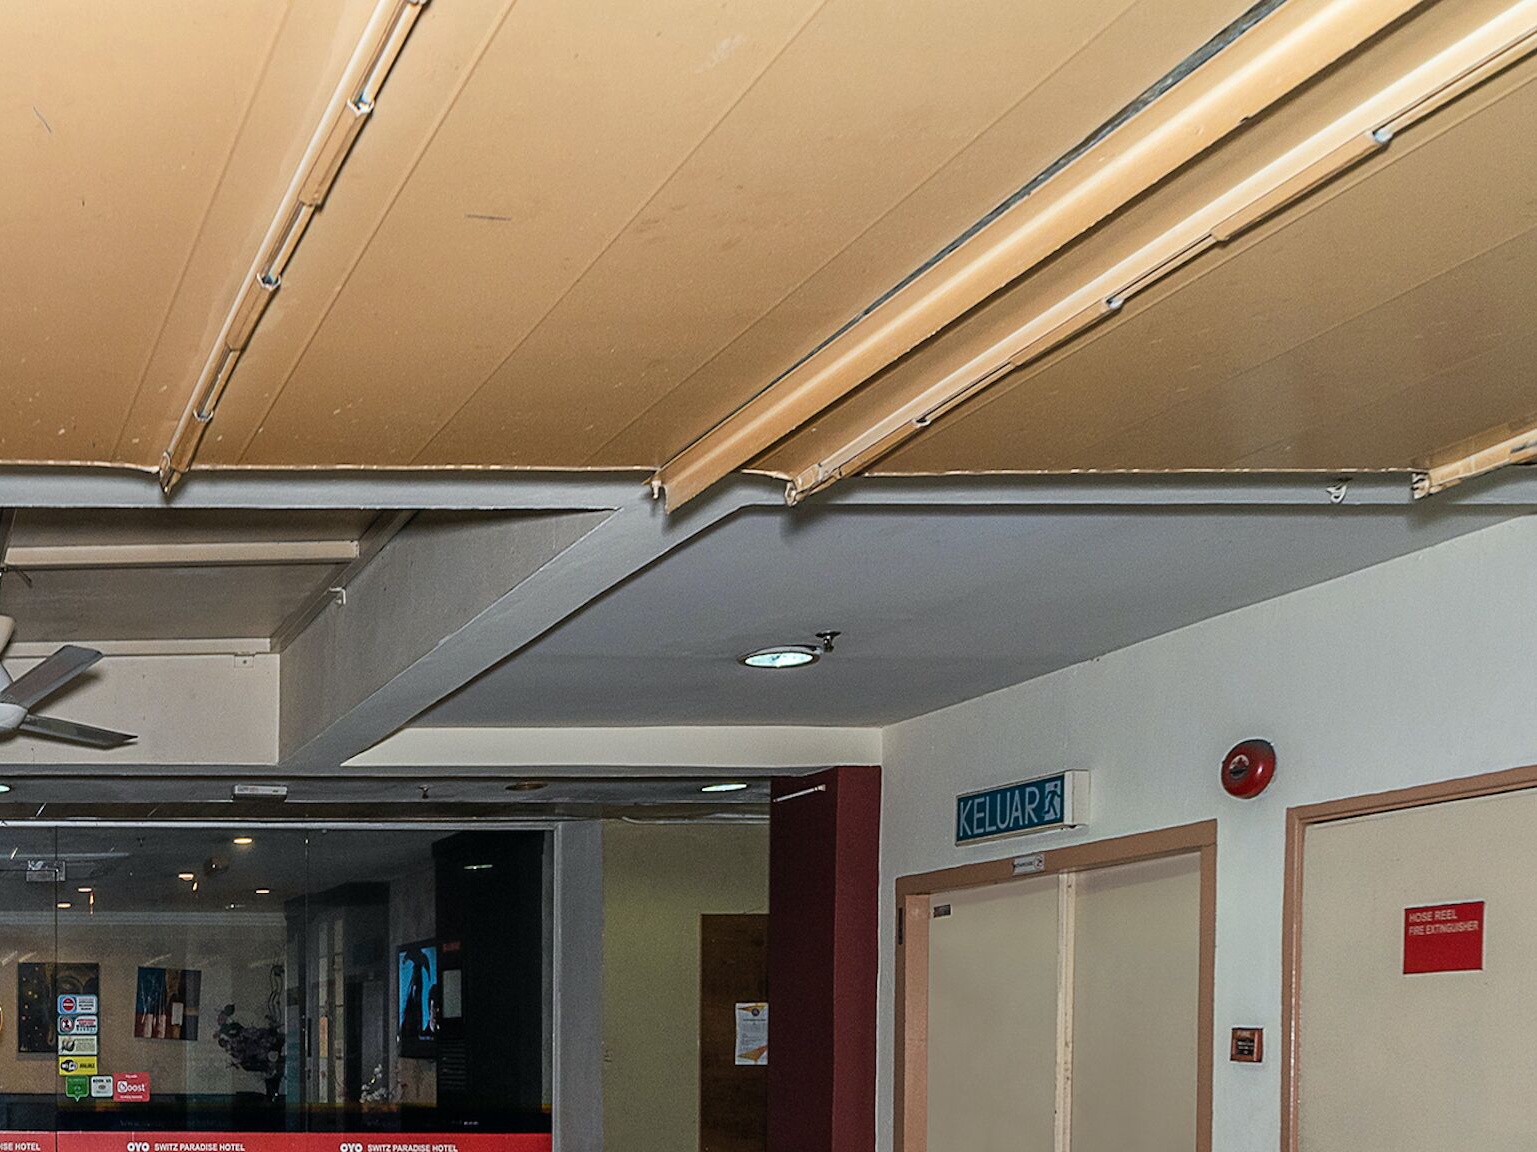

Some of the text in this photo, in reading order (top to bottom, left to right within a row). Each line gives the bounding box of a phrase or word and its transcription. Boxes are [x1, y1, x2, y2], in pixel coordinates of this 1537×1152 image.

[959, 786, 1040, 837] KELUAR
[1409, 909, 1458, 922] HOSE REEL
[15, 1142, 41, 1151] HOTEL
[127, 1141, 245, 1152] OYO SWITZ PARADISE HOTEL
[340, 1142, 458, 1152] OYO SWITZ PARADISE HOTEL
